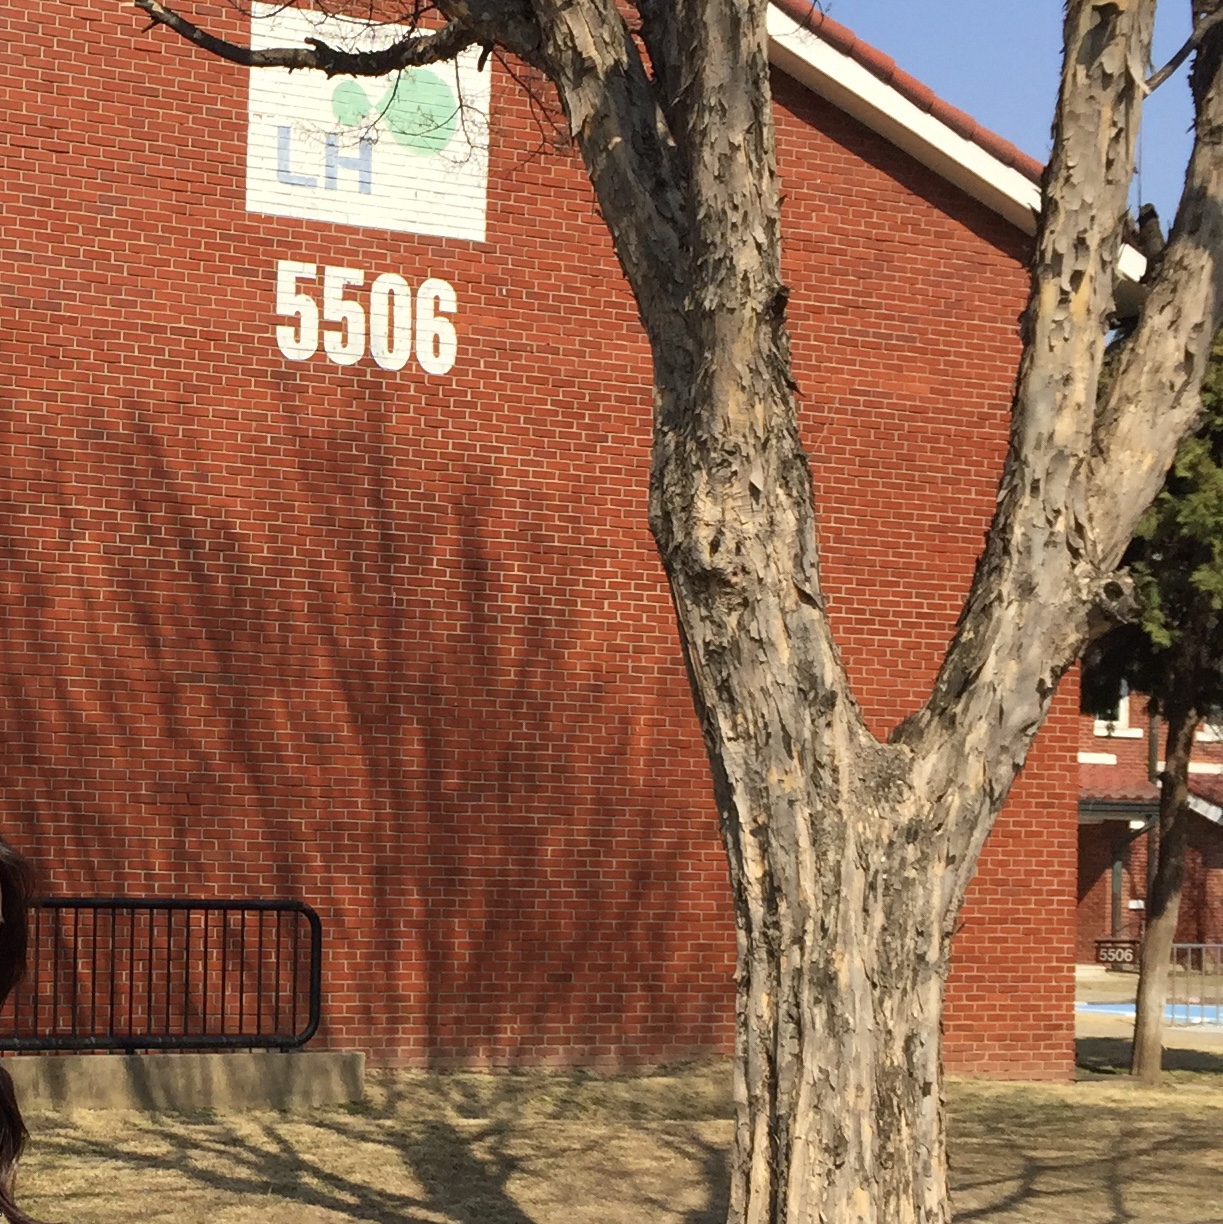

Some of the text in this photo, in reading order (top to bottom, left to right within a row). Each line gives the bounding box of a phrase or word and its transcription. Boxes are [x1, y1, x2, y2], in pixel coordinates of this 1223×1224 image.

[277, 126, 373, 195] LH
[276, 260, 458, 375] 5506
[1099, 948, 1134, 962] 5506
